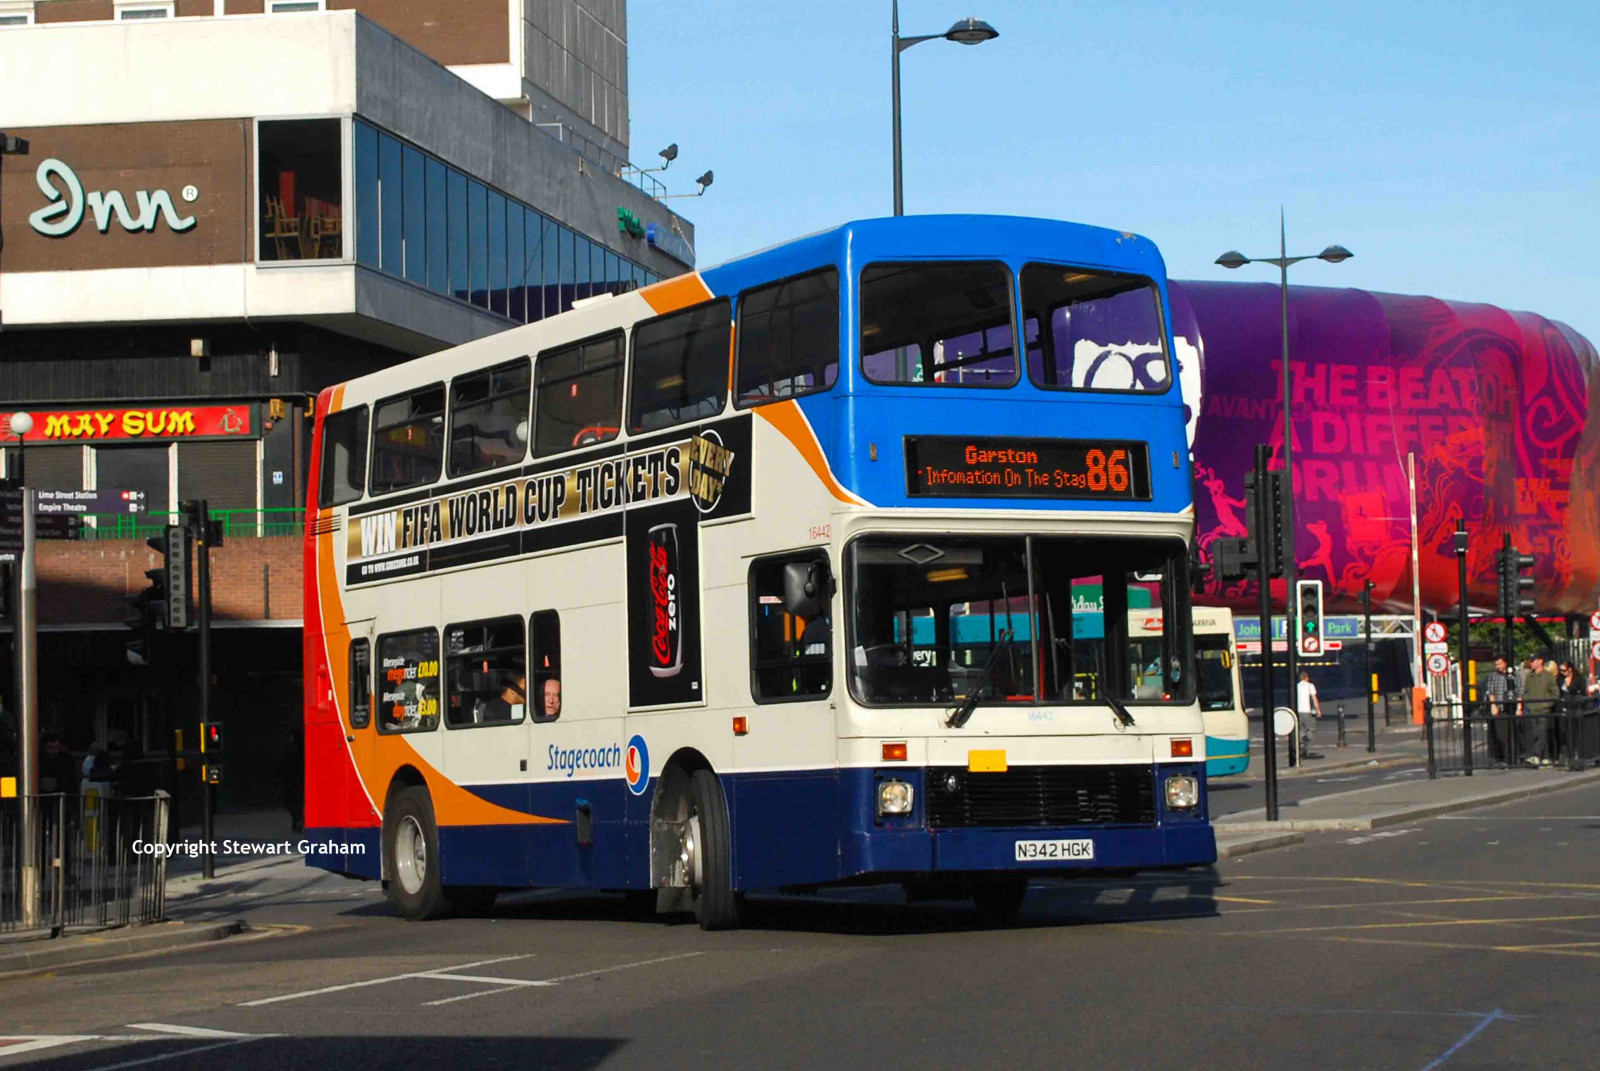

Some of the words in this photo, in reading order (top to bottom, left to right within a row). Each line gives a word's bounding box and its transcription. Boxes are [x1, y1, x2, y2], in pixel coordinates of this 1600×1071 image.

[1270, 360, 1358, 407] THE
[1367, 365, 1476, 410] BEAT
[44, 413, 115, 437] MAY
[122, 410, 195, 435] SUM
[690, 435, 735, 477] EVERY
[965, 445, 1038, 465] Garston
[926, 467, 1001, 486] Infomation
[1005, 468, 1022, 487] On
[1025, 469, 1049, 487] The
[1053, 470, 1086, 489] Stag
[1085, 449, 1129, 492] 86
[38, 491, 54, 499] Lime
[55, 491, 74, 499] Street
[75, 491, 97, 499] Station
[361, 511, 397, 558] WIN
[401, 501, 442, 549] FIFA
[448, 483, 517, 540] WORLD
[523, 474, 566, 526] CUP
[576, 446, 681, 515] TICKETS
[39, 503, 61, 512] Empire
[63, 503, 87, 511] Theatre
[809, 525, 831, 540] 16442
[667, 574, 676, 630] zero
[1328, 622, 1352, 633] Park
[1434, 658, 1442, 669] 5
[547, 743, 621, 777] Stagecoach
[1018, 843, 1058, 858] N342
[1061, 842, 1091, 857] HGK
